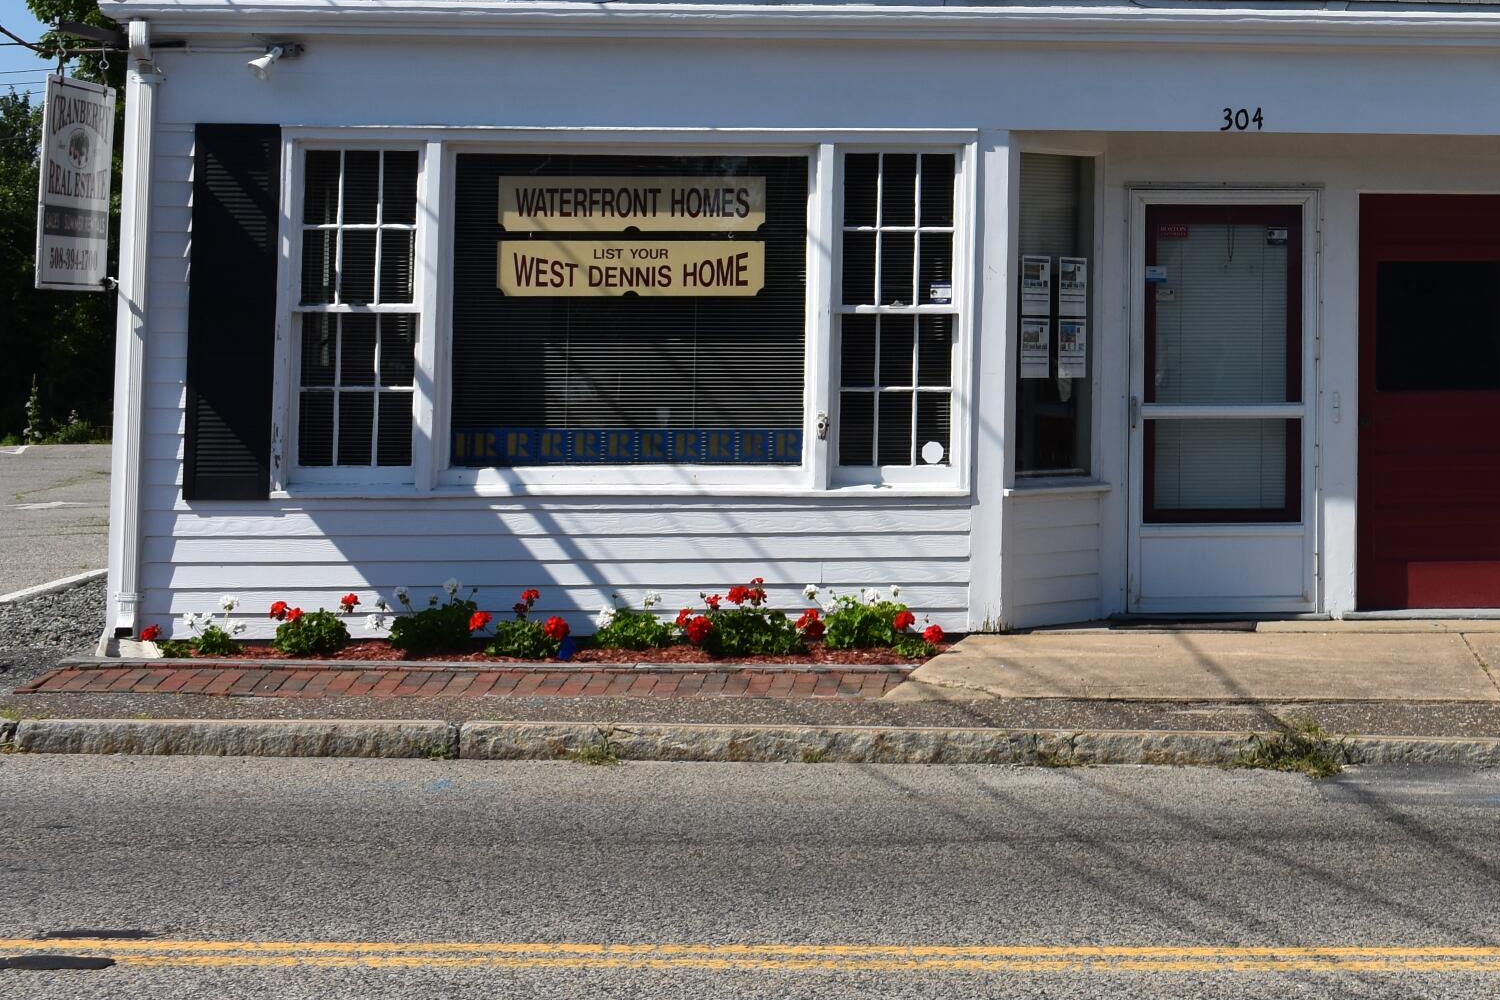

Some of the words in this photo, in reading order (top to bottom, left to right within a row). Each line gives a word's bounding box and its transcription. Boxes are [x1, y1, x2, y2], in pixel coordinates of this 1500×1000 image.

[52, 94, 111, 144] CRANBERRY
[1220, 107, 1263, 131] 304
[48, 160, 72, 196] REAL
[74, 168, 107, 200] ESTATE
[515, 187, 661, 218] WATERFRONT
[671, 187, 750, 218] HOMES
[513, 252, 579, 288] WEST
[588, 265, 672, 288] DENNIS
[683, 252, 749, 288] HOME
[593, 248, 624, 260] LIST
[630, 248, 669, 260] YOUR
